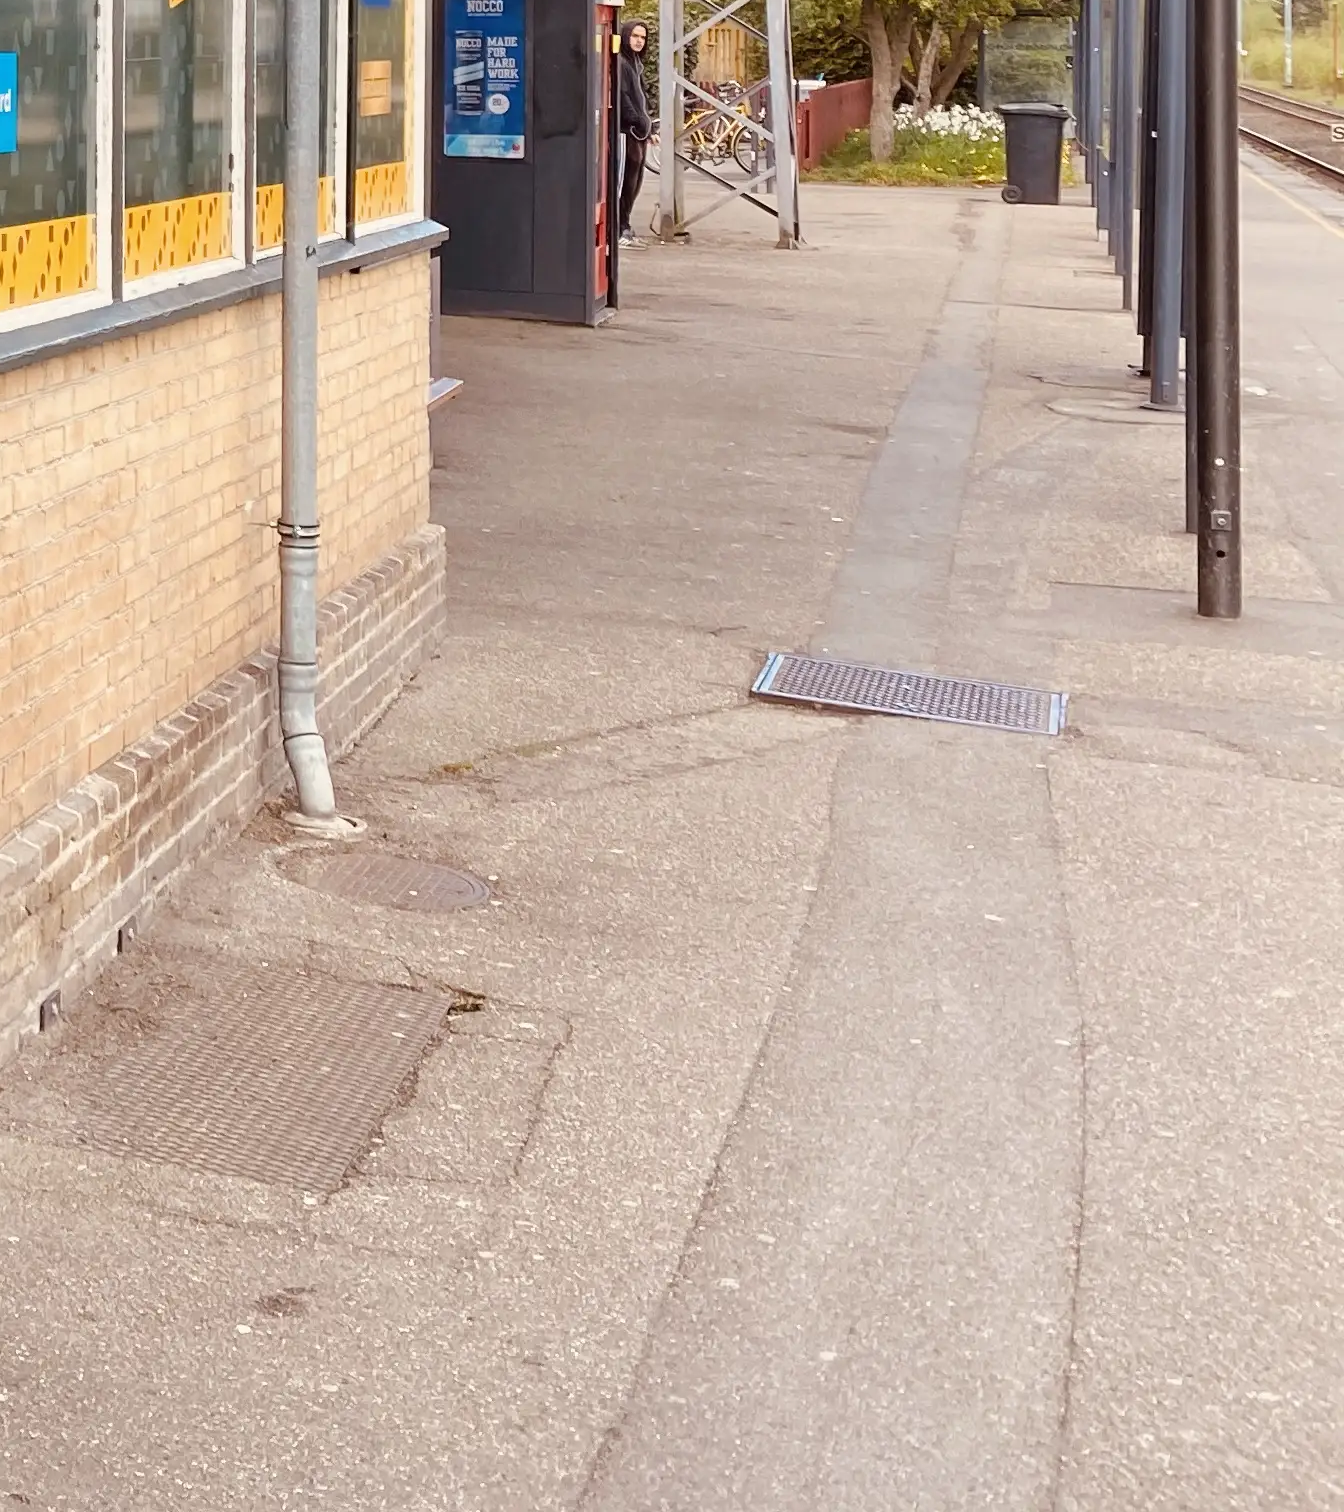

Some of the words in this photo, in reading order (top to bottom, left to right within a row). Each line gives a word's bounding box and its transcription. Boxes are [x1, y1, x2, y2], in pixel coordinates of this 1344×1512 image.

[467, 0, 504, 13] NOCCO
[487, 37, 518, 47] MADE
[487, 48, 506, 58] FOR
[487, 58, 516, 68] HARD
[487, 69, 519, 79] WORK
